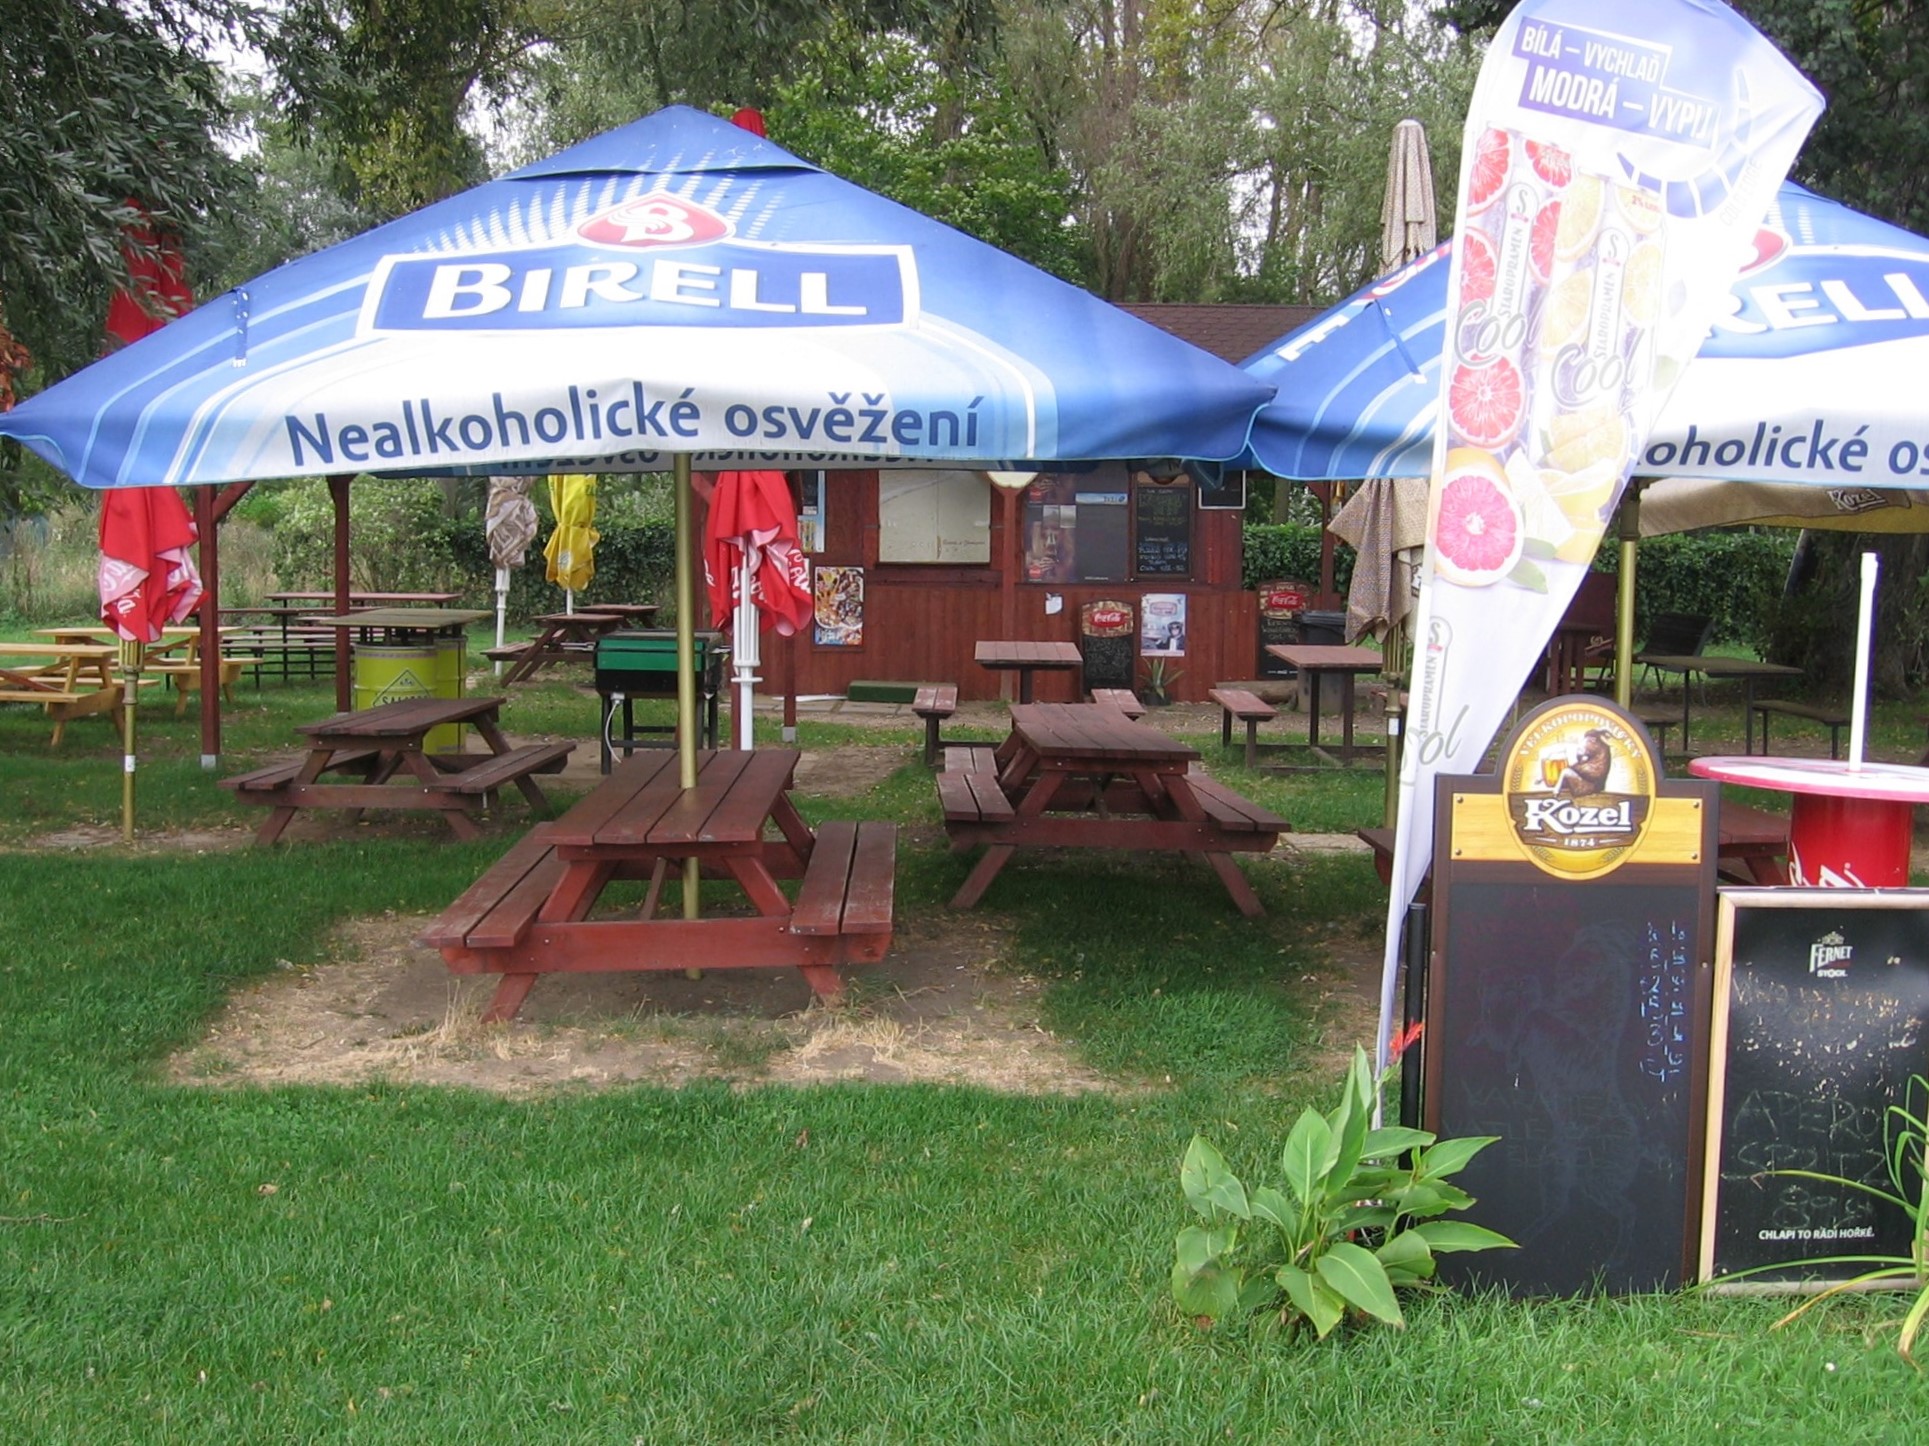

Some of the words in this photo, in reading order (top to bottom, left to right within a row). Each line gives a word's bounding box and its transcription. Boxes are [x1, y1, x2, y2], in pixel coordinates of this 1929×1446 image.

[1521, 25, 1563, 59] BÍLÁ
[1583, 41, 1660, 83] VYCHLAĎ
[1528, 65, 1620, 119] MODRÁ
[422, 260, 868, 319] BIRELL
[1499, 227, 1523, 318] STAROPRAMEN
[1593, 272, 1616, 359] STAROPRAMEN
[1551, 328, 1645, 408] Cool
[285, 381, 700, 467] Nealkoholické
[725, 391, 985, 448] osvěžení
[1641, 418, 1870, 472] oholické
[1827, 488, 1886, 511] Kozel
[1523, 798, 1632, 834] Kozel
[1563, 838, 1596, 847] 1874
[1809, 943, 1854, 973] FERNET
[1758, 1229, 1796, 1240] CHLAPI
[1797, 1229, 1812, 1240] TO
